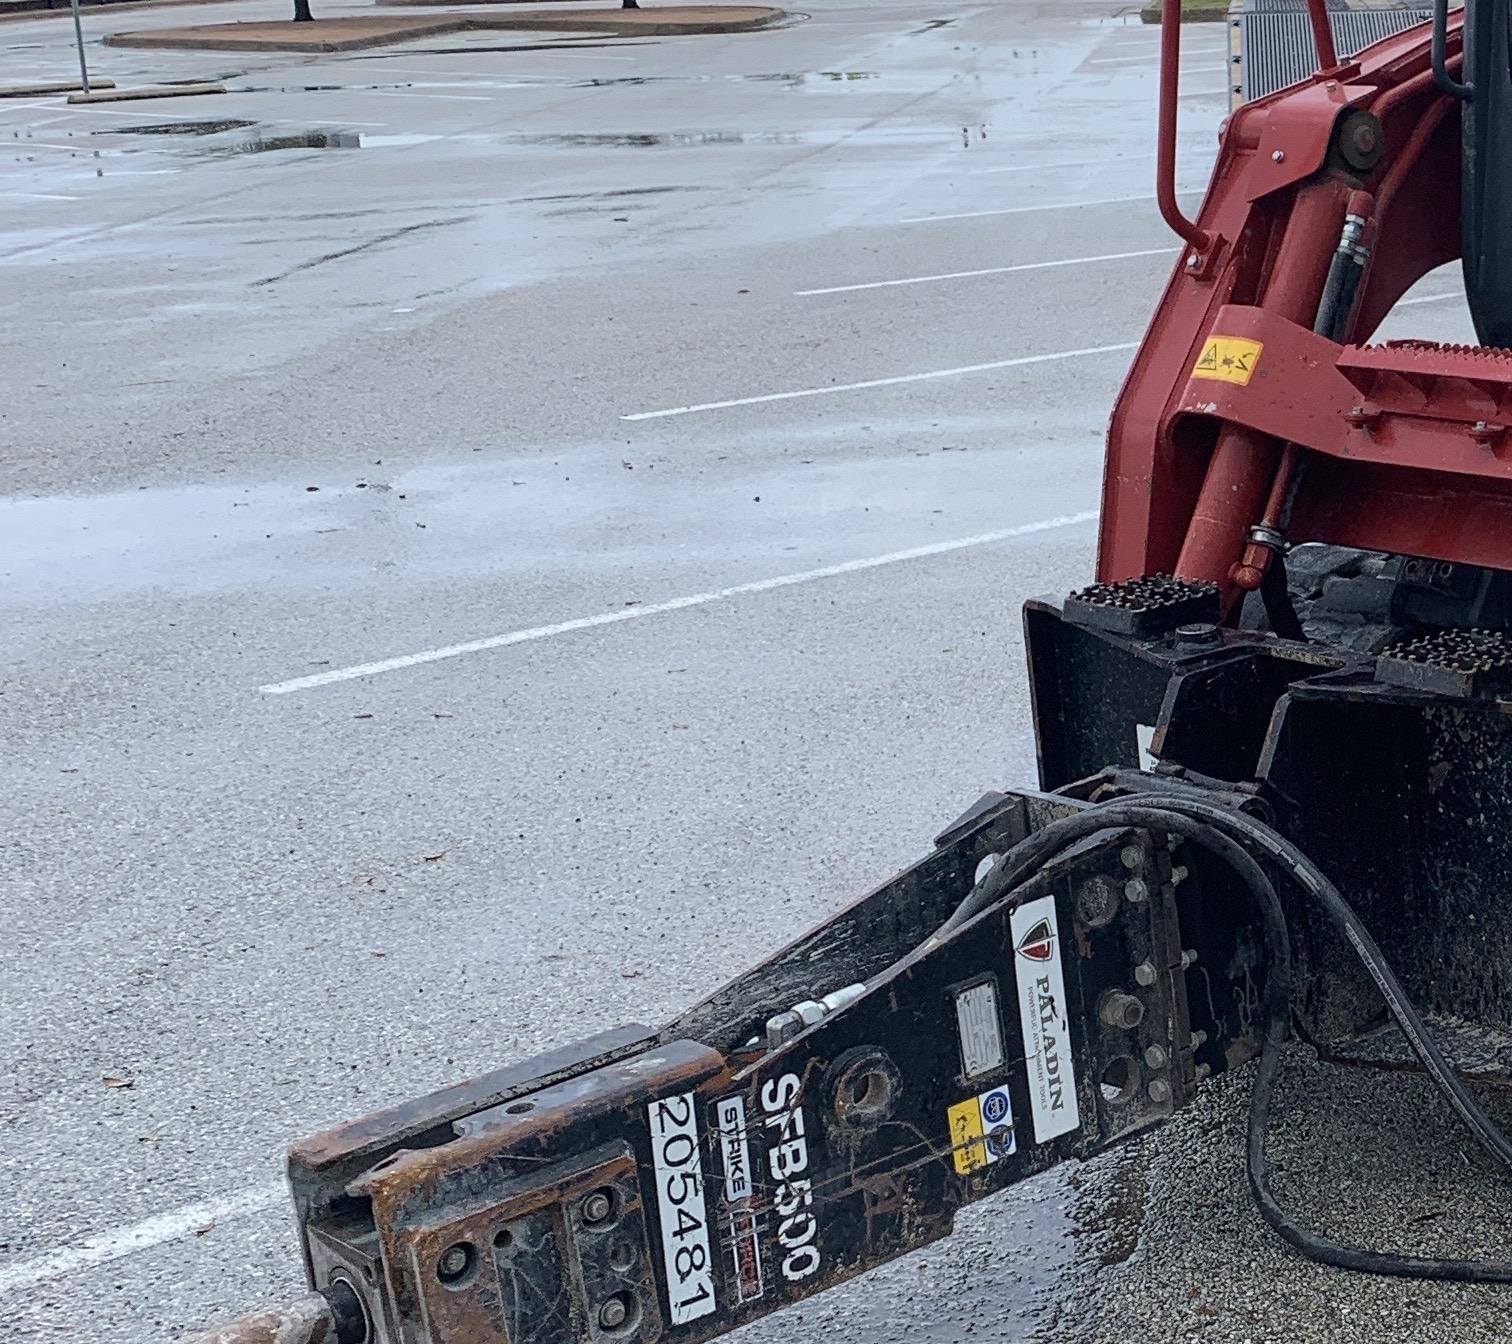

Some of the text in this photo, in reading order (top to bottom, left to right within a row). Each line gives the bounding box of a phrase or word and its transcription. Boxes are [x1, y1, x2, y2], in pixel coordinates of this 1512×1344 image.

[1036, 973, 1064, 1111] PALADIN
[658, 1095, 710, 1308] 205481
[724, 1106, 746, 1194] STRIKE
[761, 1072, 821, 1281] SFB500
